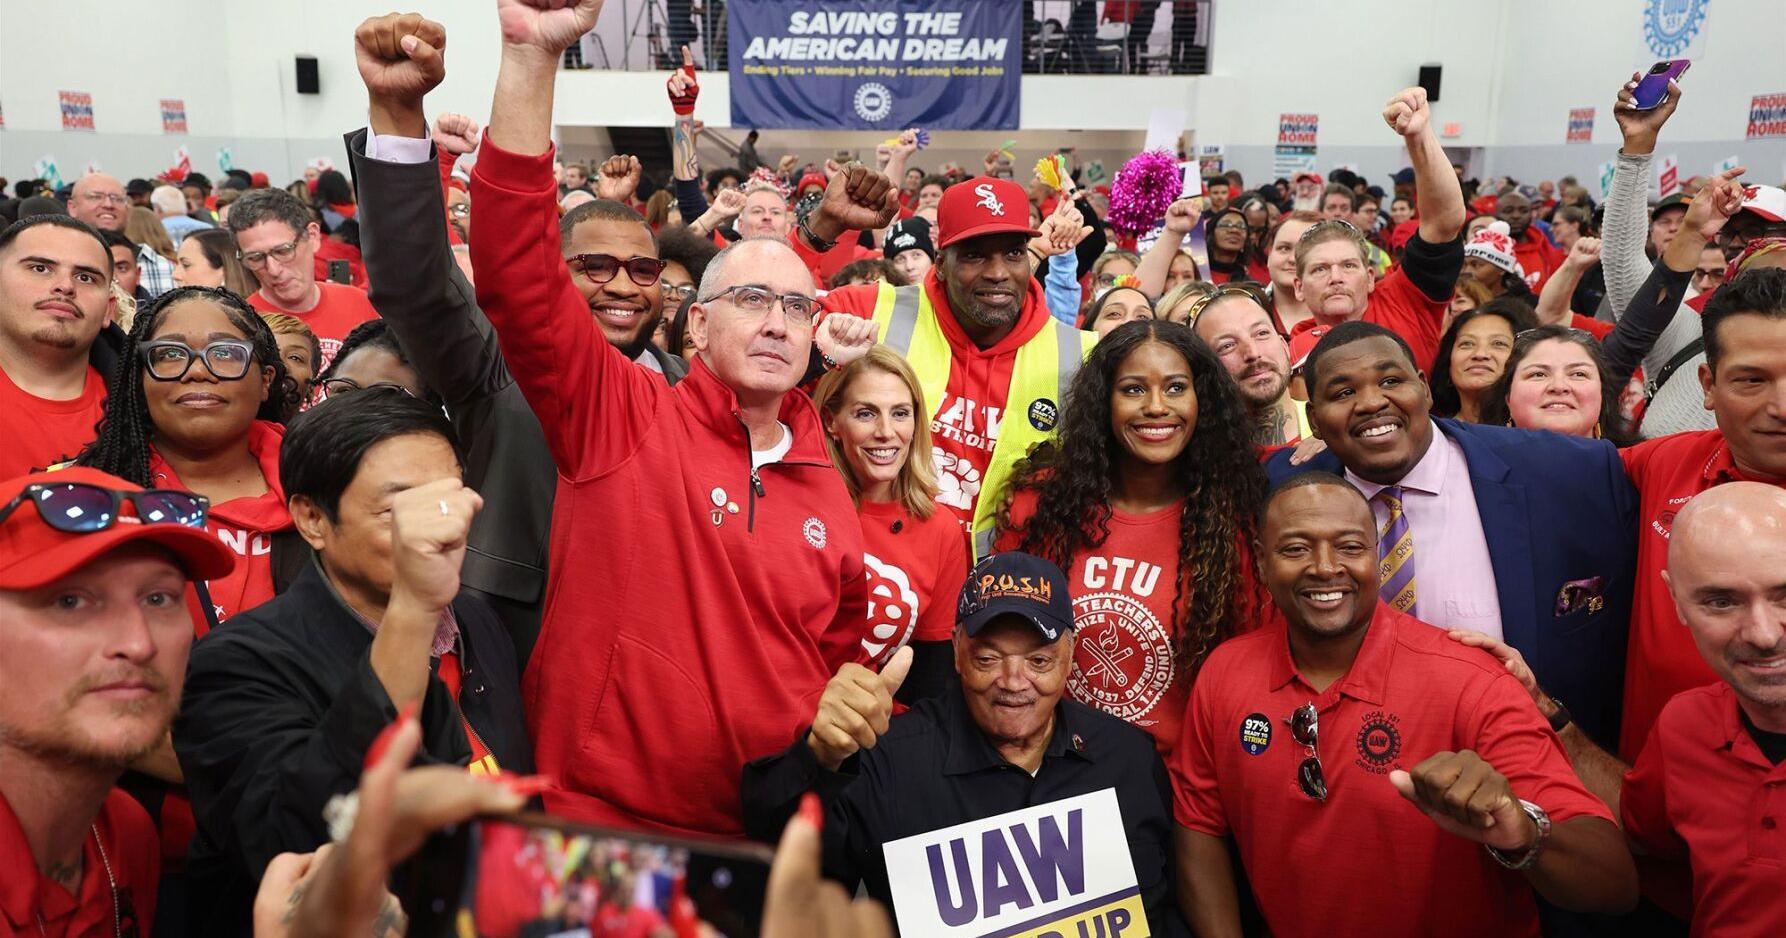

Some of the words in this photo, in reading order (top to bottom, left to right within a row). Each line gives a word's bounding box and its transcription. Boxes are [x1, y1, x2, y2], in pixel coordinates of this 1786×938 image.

[788, 11, 898, 35] SAVING
[903, 12, 962, 35] THE
[743, 37, 900, 60] AMERICAN
[902, 38, 1008, 61] DREAM
[743, 65, 779, 76] Ending
[780, 65, 805, 75] Tiers
[814, 66, 856, 77] Winning
[858, 66, 877, 76] Fair
[879, 66, 897, 77] Pay
[906, 66, 950, 77] Securing
[951, 66, 979, 76] Good
[981, 66, 1004, 76] Jobs
[1751, 96, 1786, 108] PROU
[1466, 246, 1510, 267] upreme
[1034, 401, 1056, 417] 97%
[930, 419, 997, 453] STRON
[1083, 556, 1162, 598] CTU
[1073, 613, 1105, 637] ANIZE
[1117, 616, 1150, 651] UNITE
[1079, 598, 1160, 641] TEACHERS
[1150, 644, 1171, 692] UNION
[1124, 655, 1154, 700] DEFEND
[1092, 688, 1119, 702] 1937
[1245, 719, 1269, 733] 97%
[1361, 711, 1384, 722] LOCAL
[1243, 735, 1268, 745] STRIKE
[925, 808, 1086, 928] UAW
[1076, 908, 1132, 938] UP
